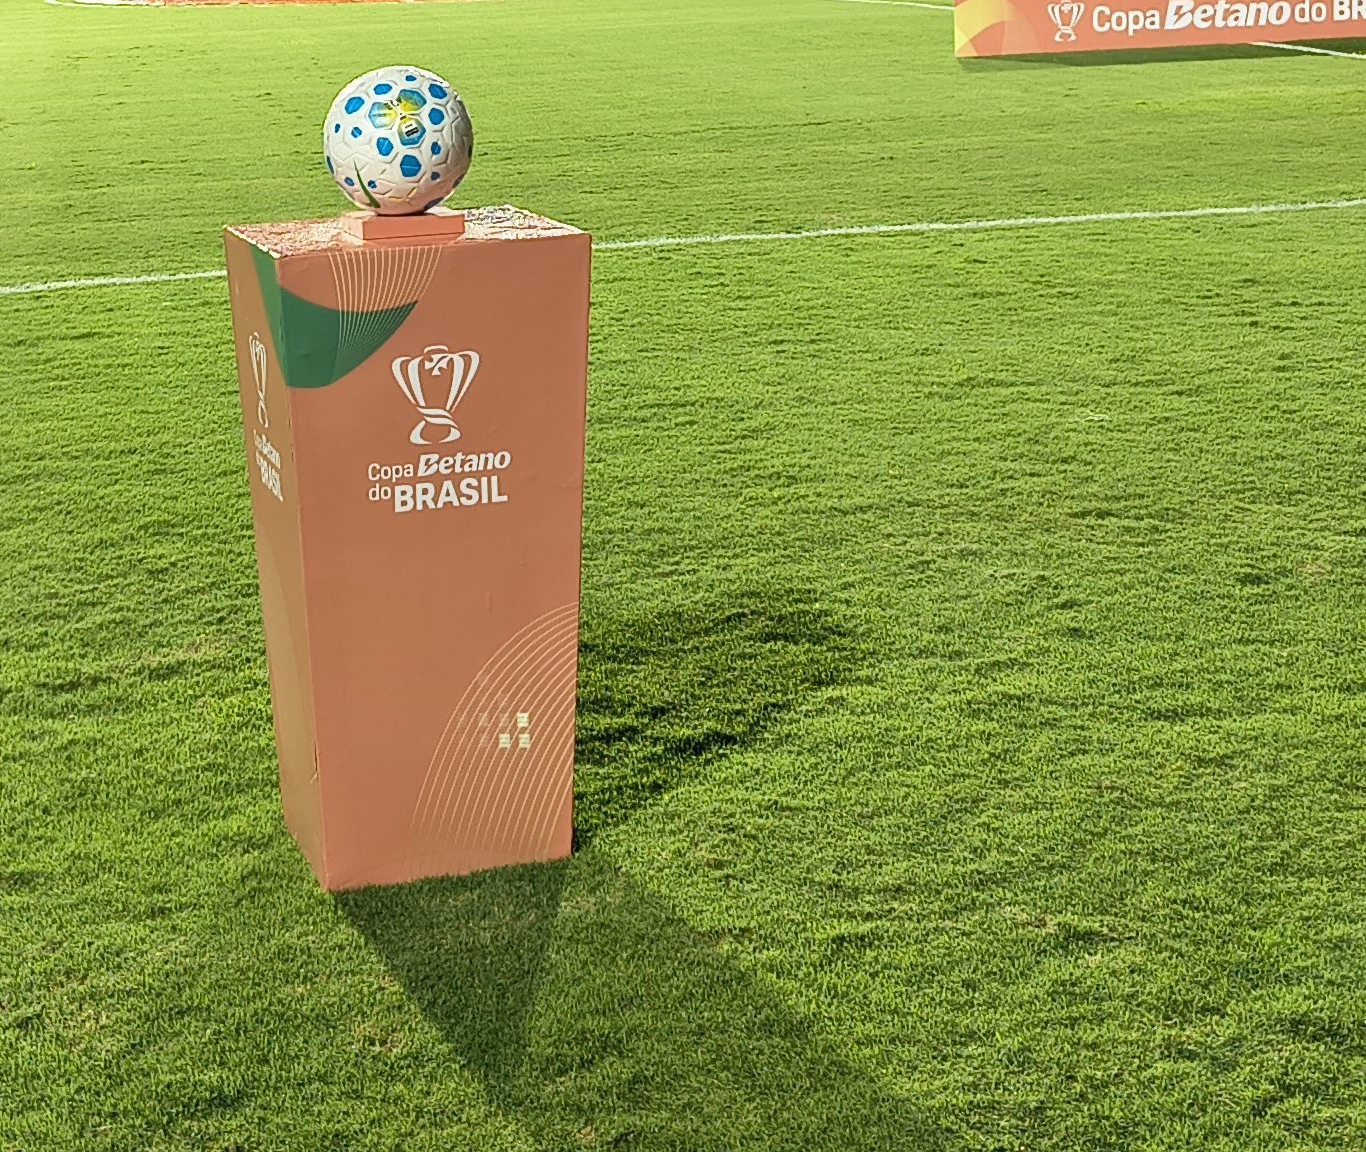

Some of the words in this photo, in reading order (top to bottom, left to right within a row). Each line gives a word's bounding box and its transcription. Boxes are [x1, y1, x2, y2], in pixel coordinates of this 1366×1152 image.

[1092, 4, 1160, 35] Copa
[1164, 0, 1292, 30] Betano
[367, 462, 414, 483] Copa
[417, 450, 512, 477] Betano
[368, 483, 392, 501] do
[394, 475, 509, 513] BRASIL
